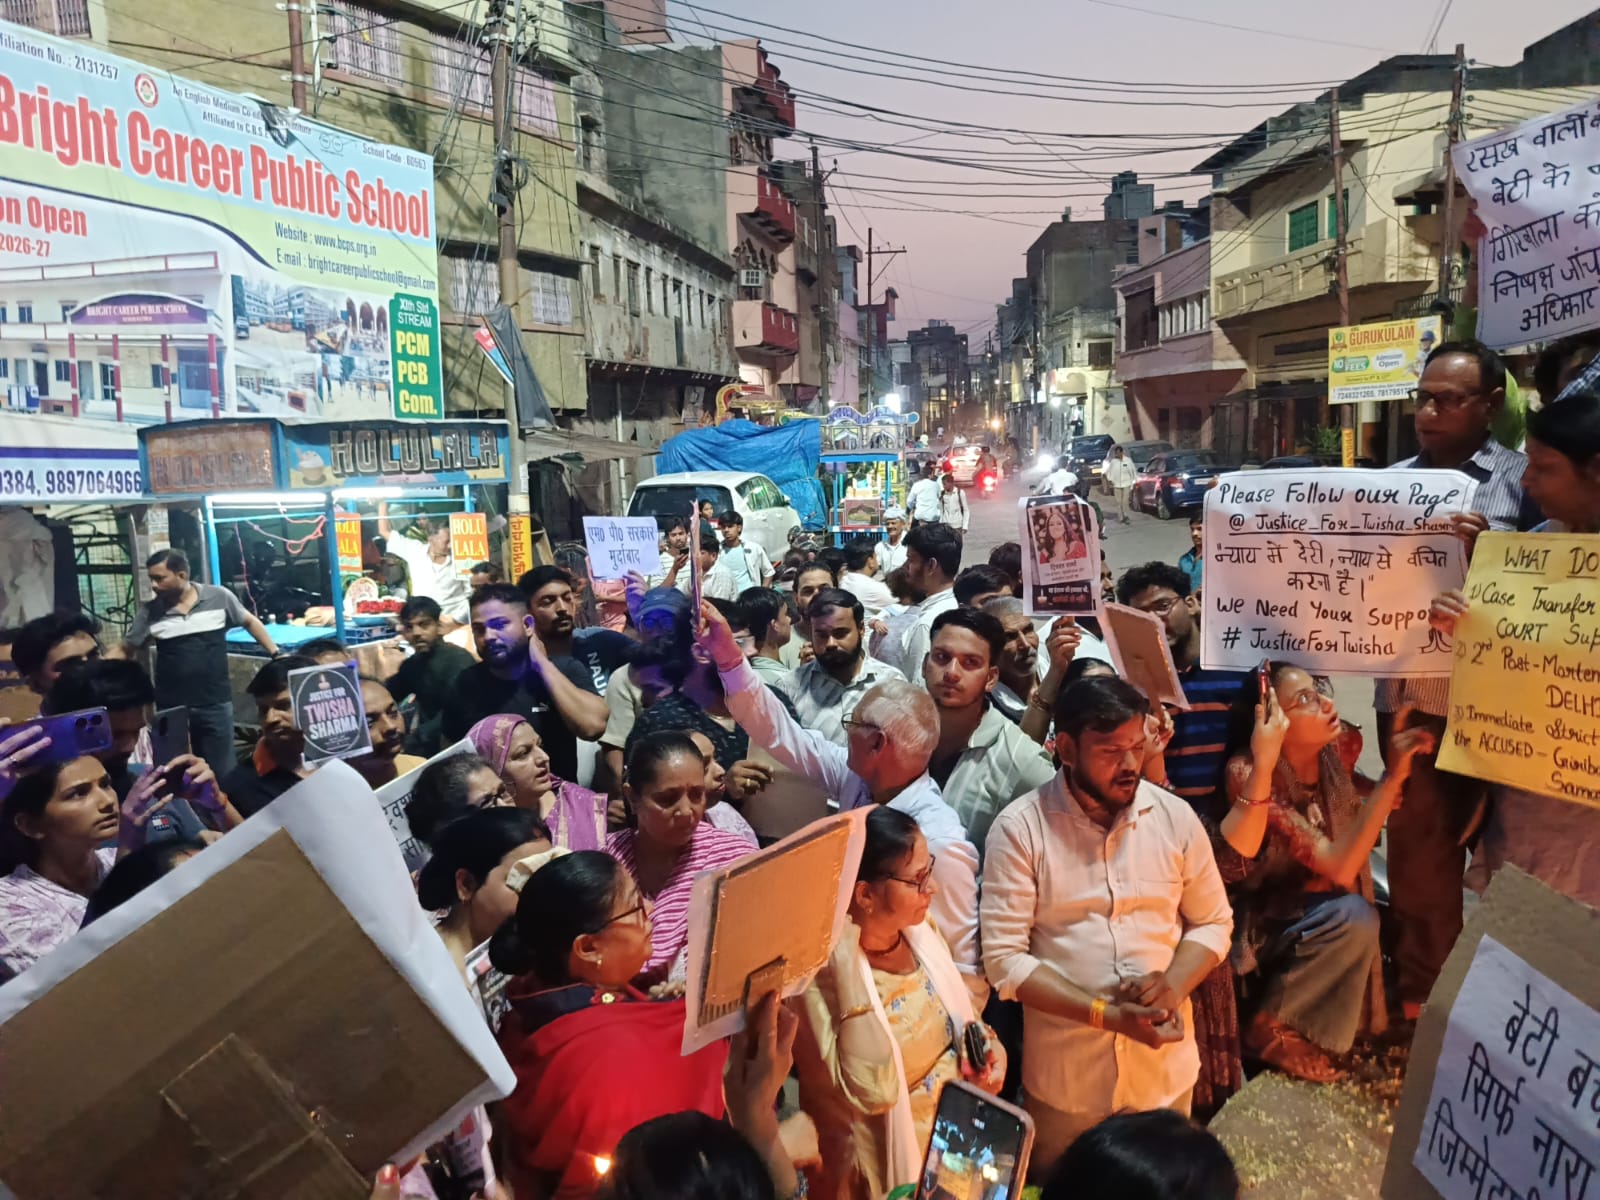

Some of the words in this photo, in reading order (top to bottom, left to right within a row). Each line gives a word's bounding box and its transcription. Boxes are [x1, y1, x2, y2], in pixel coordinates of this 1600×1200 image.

[47, 47, 66, 66] No.
[75, 55, 119, 80] 2131257
[185, 88, 211, 106] English
[213, 97, 241, 114] Medium
[202, 111, 236, 130] Affiliated
[0, 73, 122, 168] Bright
[127, 110, 244, 196] Career
[251, 143, 341, 218] Public
[346, 169, 430, 239] School
[362, 142, 385, 159] School
[386, 149, 402, 163] Code
[1491, 168, 1533, 206] बेटी
[26, 195, 88, 237] Open
[275, 221, 308, 243] Website
[276, 248, 302, 267] E-mail
[397, 312, 432, 328] STREAM
[395, 330, 430, 357] PCM
[1349, 325, 1415, 346] GURUKULAM
[397, 360, 429, 385] PCB
[1378, 360, 1400, 369] Open
[399, 389, 438, 415] Com.
[330, 428, 499, 477] HOLULALA
[0, 469, 41, 496] 384,
[46, 469, 142, 495] 9897064966
[1219, 483, 1275, 504] Please
[1286, 481, 1344, 504] Follow
[1408, 482, 1460, 518] Page
[453, 517, 485, 536] HOLU
[626, 525, 656, 541] सरकार
[455, 539, 486, 557] LALA
[608, 543, 640, 571] मुर्दाबाद
[1504, 545, 1551, 571] WHAT
[1569, 546, 1600, 575] DO
[1287, 571, 1331, 591] करना
[1216, 597, 1245, 613] We
[1255, 599, 1299, 618] Need
[1310, 600, 1352, 622] Your
[1368, 607, 1431, 631] Suppo
[1532, 586, 1596, 622] Transfer
[303, 697, 356, 723] TWISHA
[1466, 704, 1535, 734] Immediate
[308, 715, 360, 740] SHARMA
[1479, 732, 1534, 758] ACCUSED
[1505, 984, 1559, 1078] बेटी
